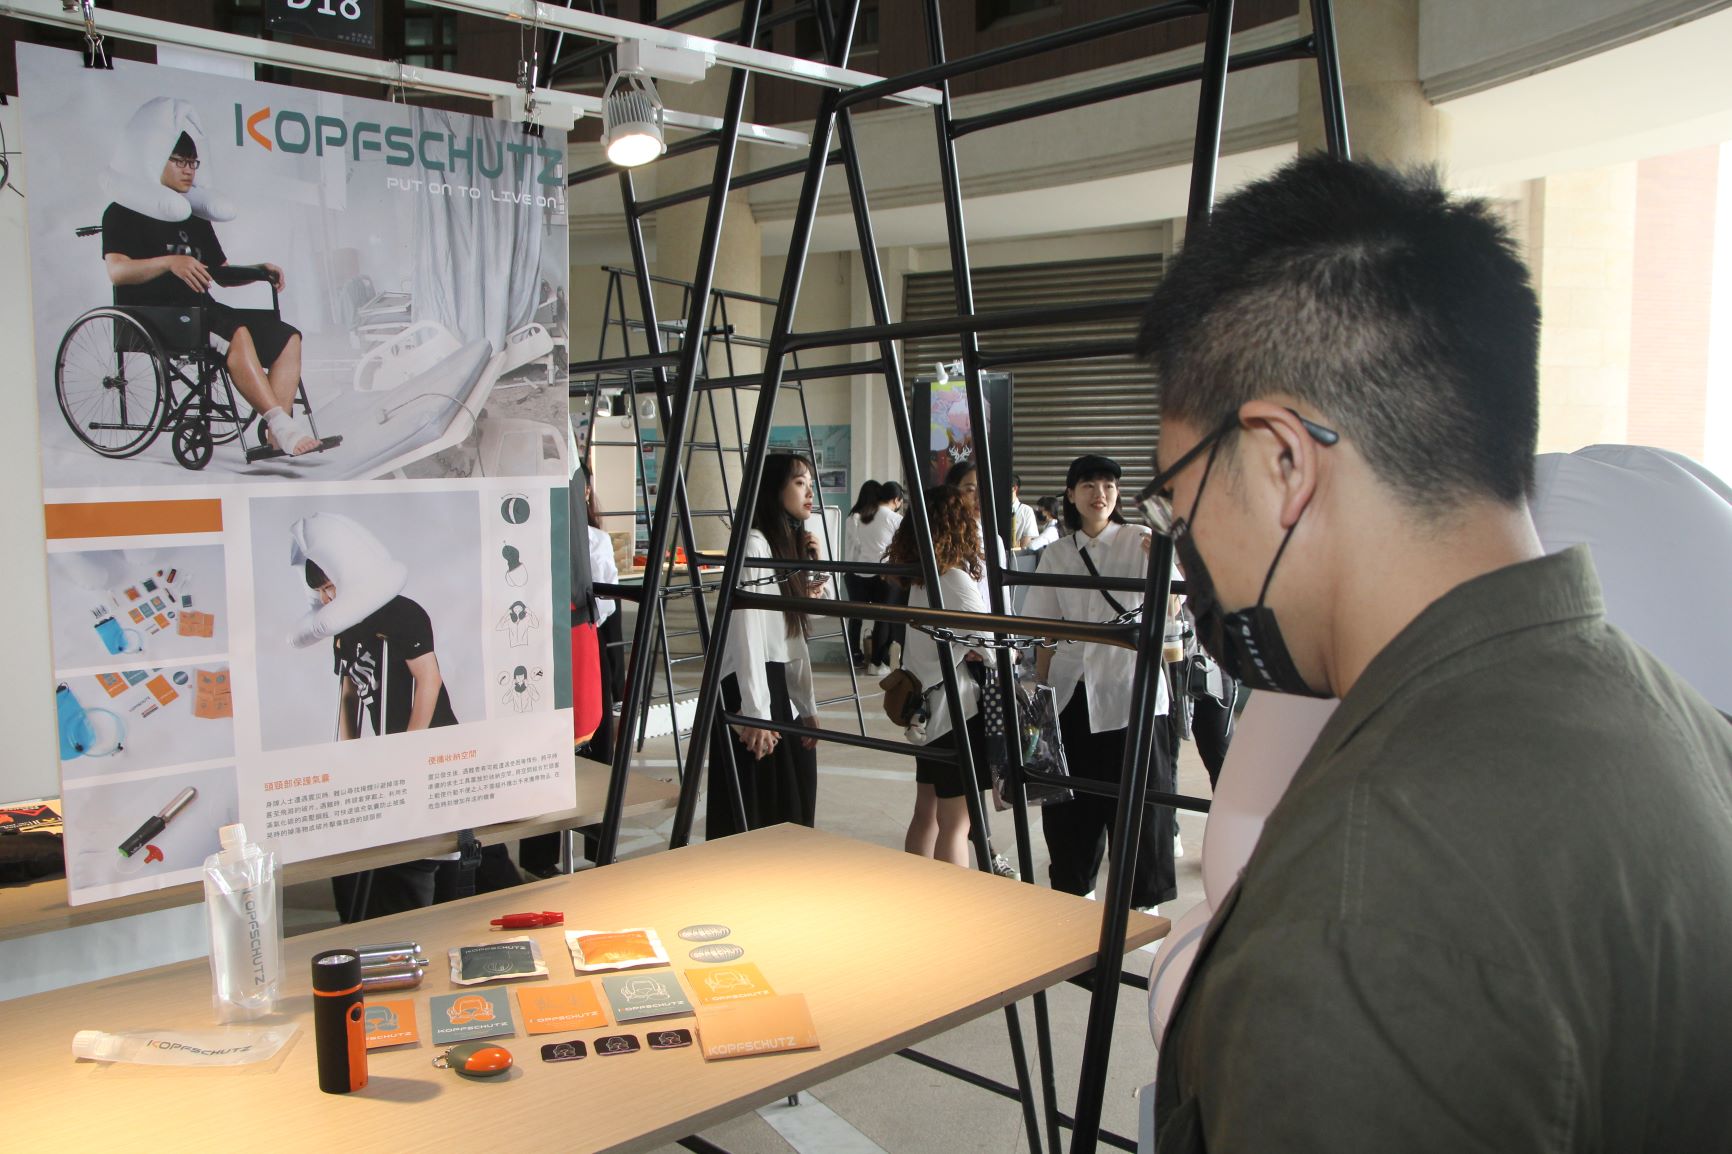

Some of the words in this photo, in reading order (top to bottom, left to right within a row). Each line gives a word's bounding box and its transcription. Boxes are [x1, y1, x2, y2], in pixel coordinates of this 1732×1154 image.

[287, 0, 361, 20] 18
[234, 102, 564, 187] KOPFSCHUTZ
[387, 177, 423, 192] PUT
[458, 186, 481, 199] TO
[491, 189, 532, 205] LIVE
[243, 887, 265, 986] KOPFSCHUTZ
[437, 1021, 509, 1034] KOPFSCHUTZ
[147, 1039, 253, 1056] KOPFSCHUTZ
[708, 1036, 797, 1056] KOPFSCHUTZ
